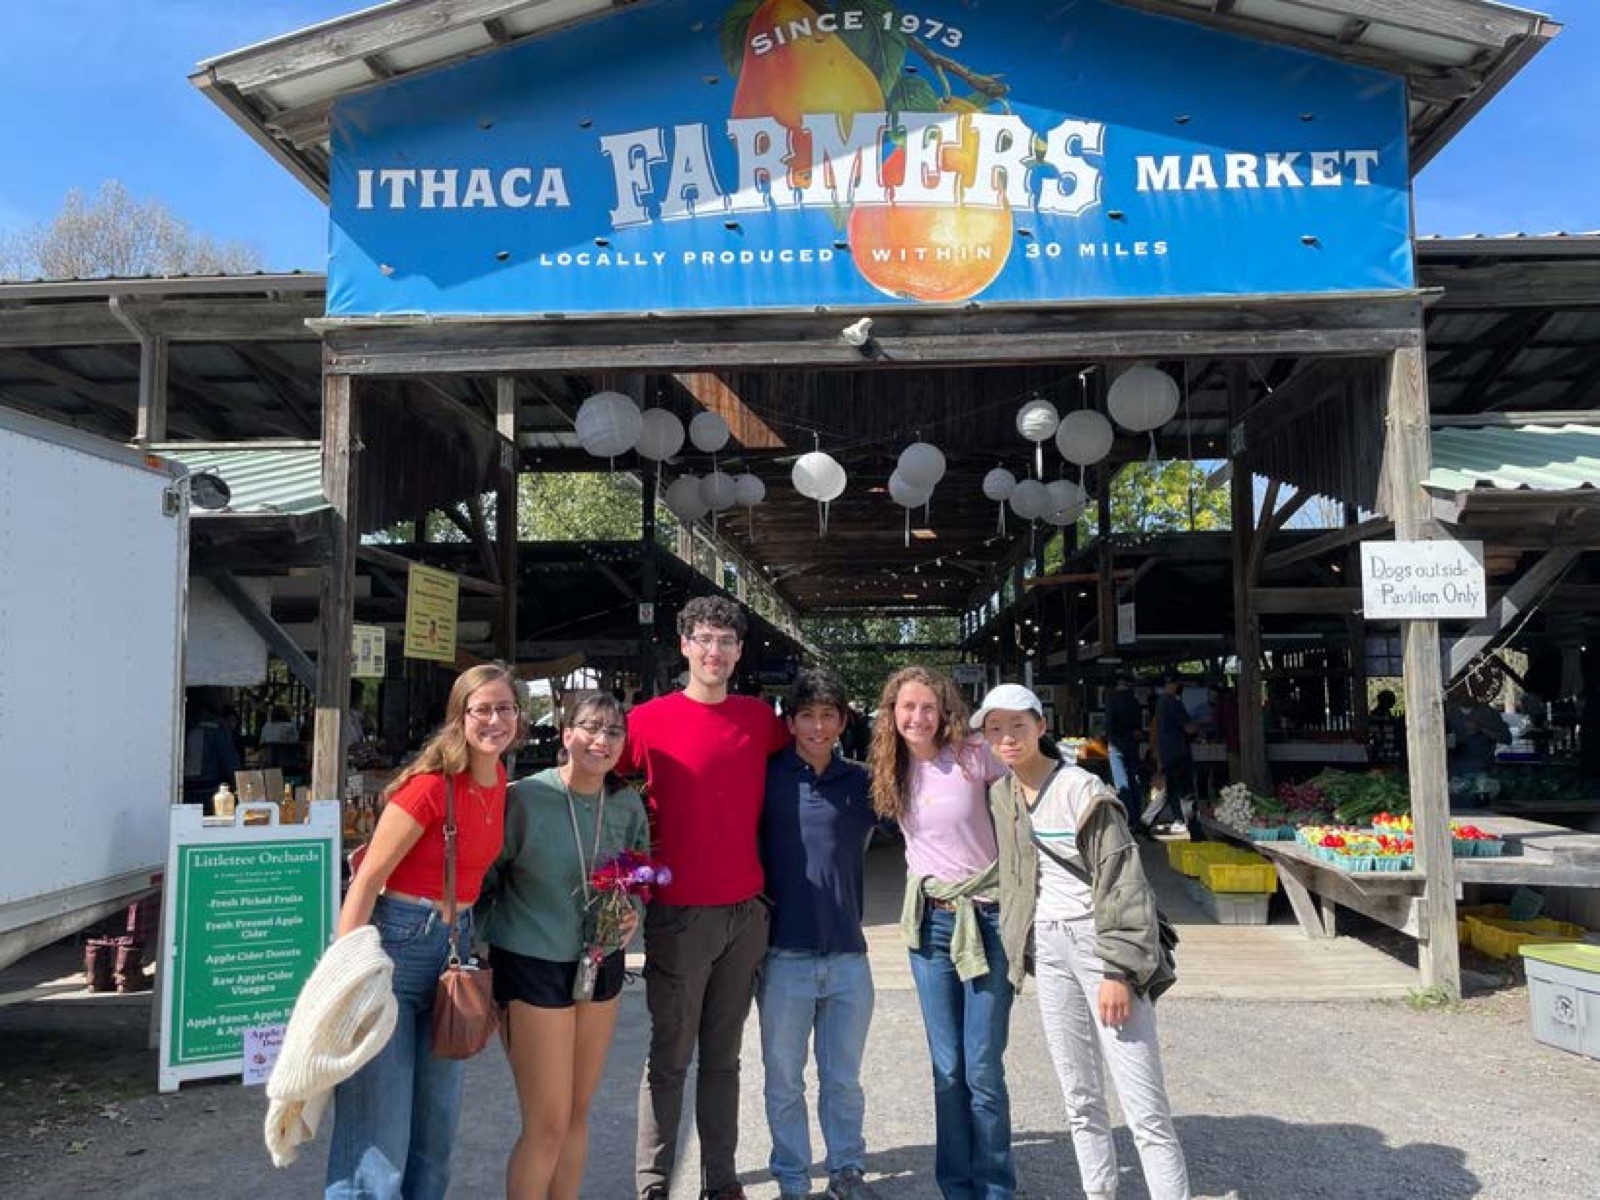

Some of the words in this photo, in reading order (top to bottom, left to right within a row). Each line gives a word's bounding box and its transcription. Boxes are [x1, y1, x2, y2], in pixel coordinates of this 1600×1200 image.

[750, 11, 863, 56] SINCE
[883, 11, 964, 48] 1973
[356, 167, 571, 210] ITHACA
[600, 112, 1107, 230] FARMERS
[1136, 149, 1379, 192] MARKET
[540, 251, 668, 266] LOCALLY
[683, 248, 834, 265] PRODUCED
[872, 246, 992, 262] WITHIN
[1025, 243, 1062, 258] 30
[1080, 241, 1169, 257] MILES
[1370, 555, 1412, 582] Dogs
[1381, 582, 1440, 605] Pavilion
[1443, 582, 1480, 608] Only
[194, 854, 256, 868] Littletree
[258, 849, 319, 865] Orchards
[205, 921, 234, 932] Fresh
[275, 915, 304, 927] Apple
[241, 929, 269, 939] Cider
[205, 953, 235, 966] Apple
[237, 951, 265, 961] Cider
[236, 973, 266, 985] Apple
[267, 971, 294, 981] Cider
[187, 1016, 217, 1029] Apple
[253, 1009, 282, 1021] Apple
[250, 1028, 281, 1040] Apple
